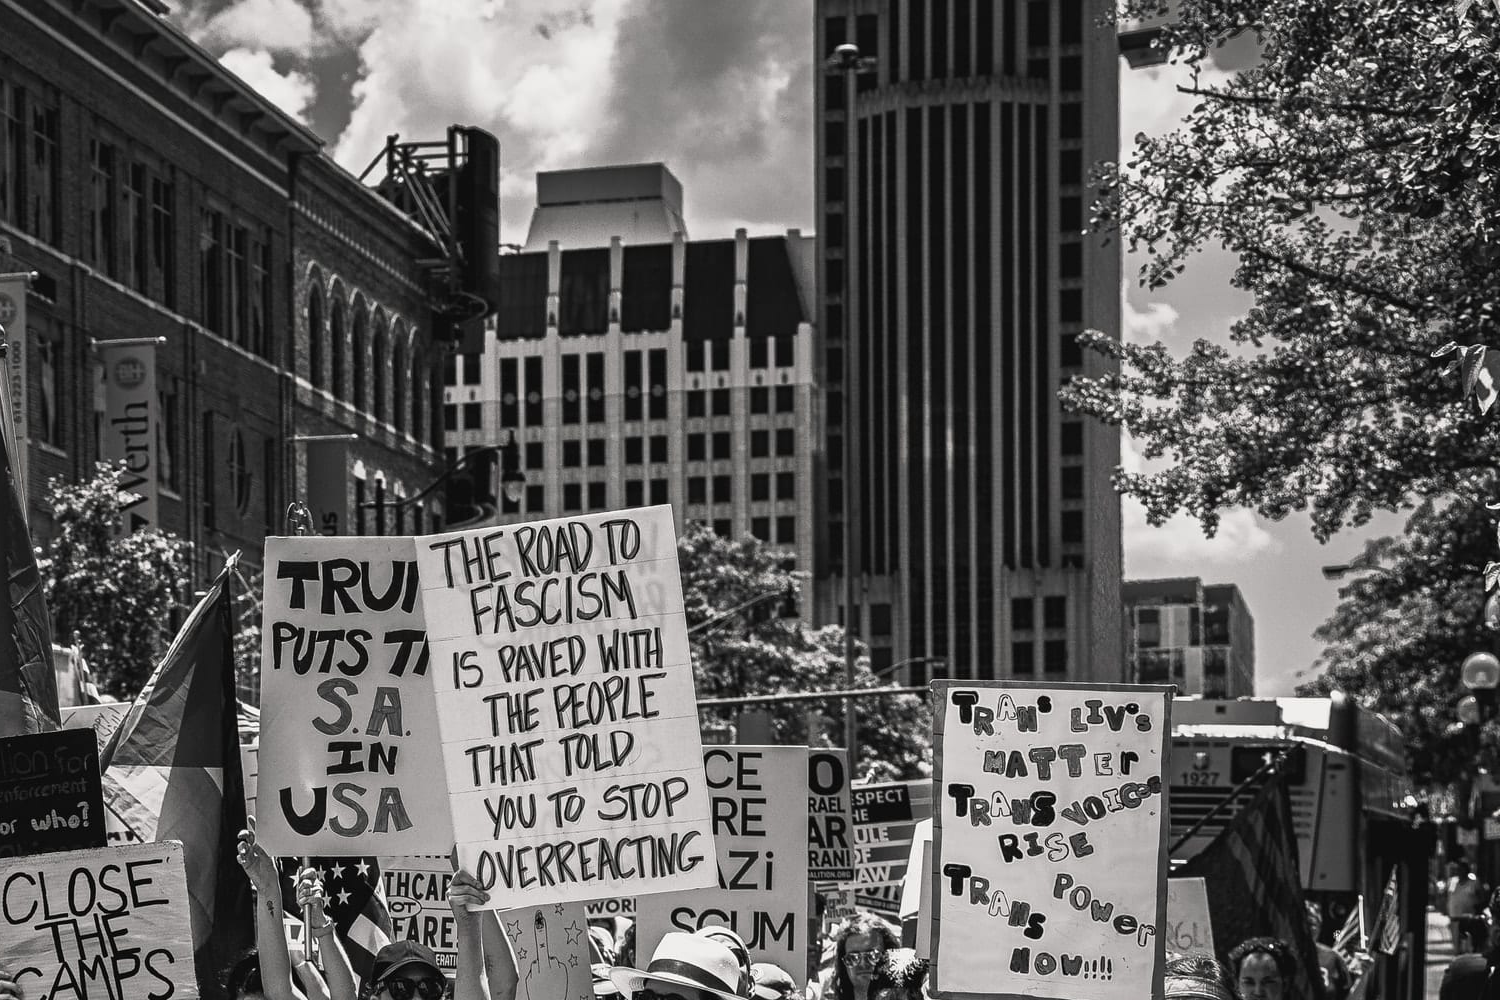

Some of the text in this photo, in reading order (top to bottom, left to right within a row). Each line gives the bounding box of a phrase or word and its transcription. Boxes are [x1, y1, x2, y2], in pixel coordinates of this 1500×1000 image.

[430, 519, 640, 588] THE ROAD TO
[470, 570, 637, 635] FASCISM
[272, 621, 372, 676] PUTS
[453, 627, 663, 689] IS PAVED WITH
[483, 672, 667, 736] THE PEOPLE
[326, 741, 397, 775] IN
[465, 730, 635, 786] THAT TOLD
[1181, 772, 1220, 785] 1927
[31, 801, 91, 833] who?
[484, 794, 537, 840] YOU
[598, 776, 689, 821] STOP
[948, 783, 1057, 827] TRANS
[477, 831, 704, 891] OVERREACTING
[998, 832, 1095, 863] RISE
[2, 858, 169, 925] CLOSE
[943, 863, 1047, 940] TRANS
[34, 911, 141, 964] THE
